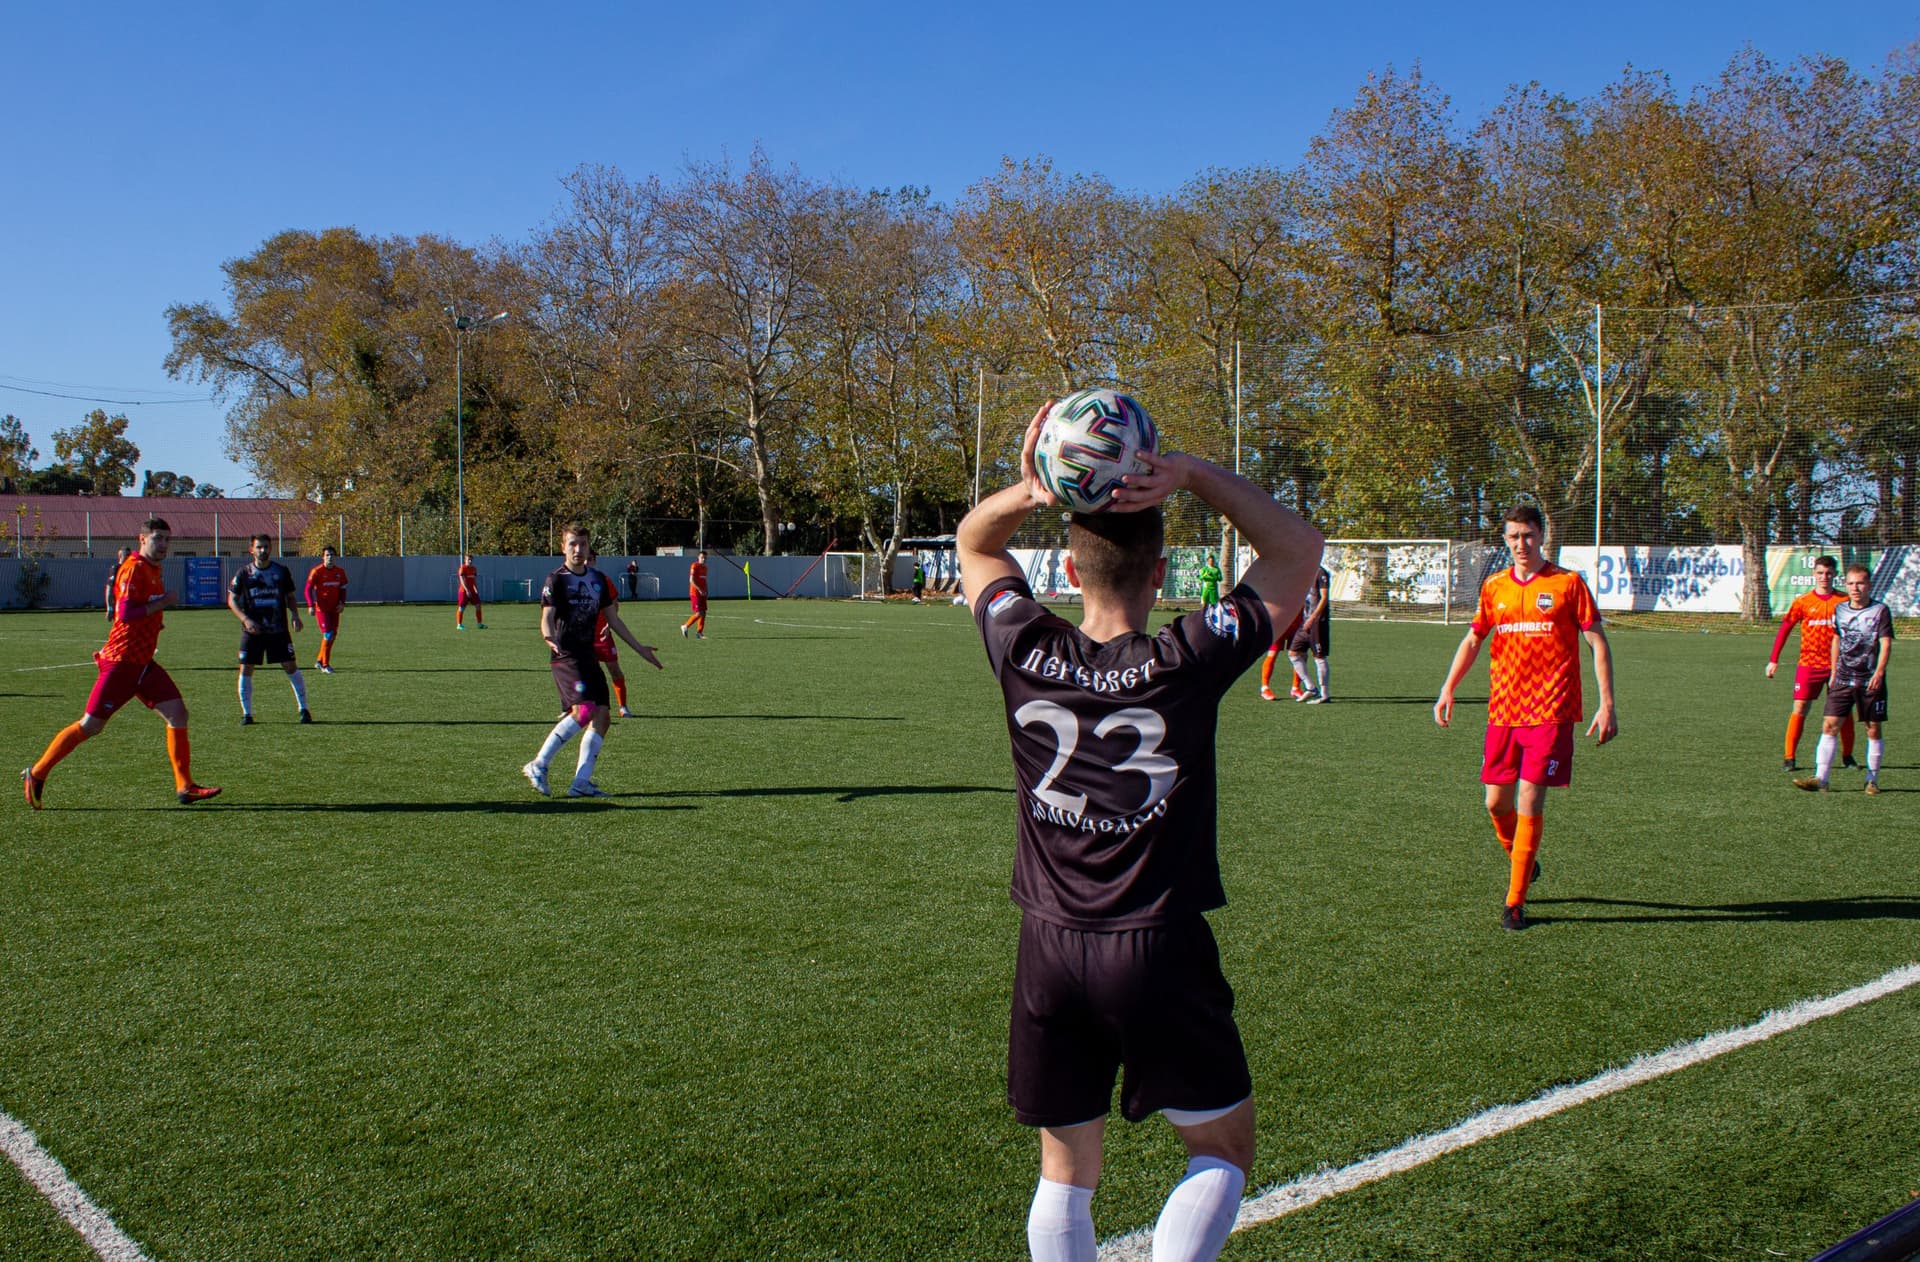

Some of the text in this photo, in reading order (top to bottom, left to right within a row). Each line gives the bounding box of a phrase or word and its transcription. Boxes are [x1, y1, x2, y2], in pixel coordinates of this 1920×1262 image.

[1600, 555, 1614, 594] 3
[1618, 577, 1701, 598] РЕКОРДА
[1020, 648, 1157, 693] ПЕРЕСВЕТ
[1014, 699, 1180, 817] 23
